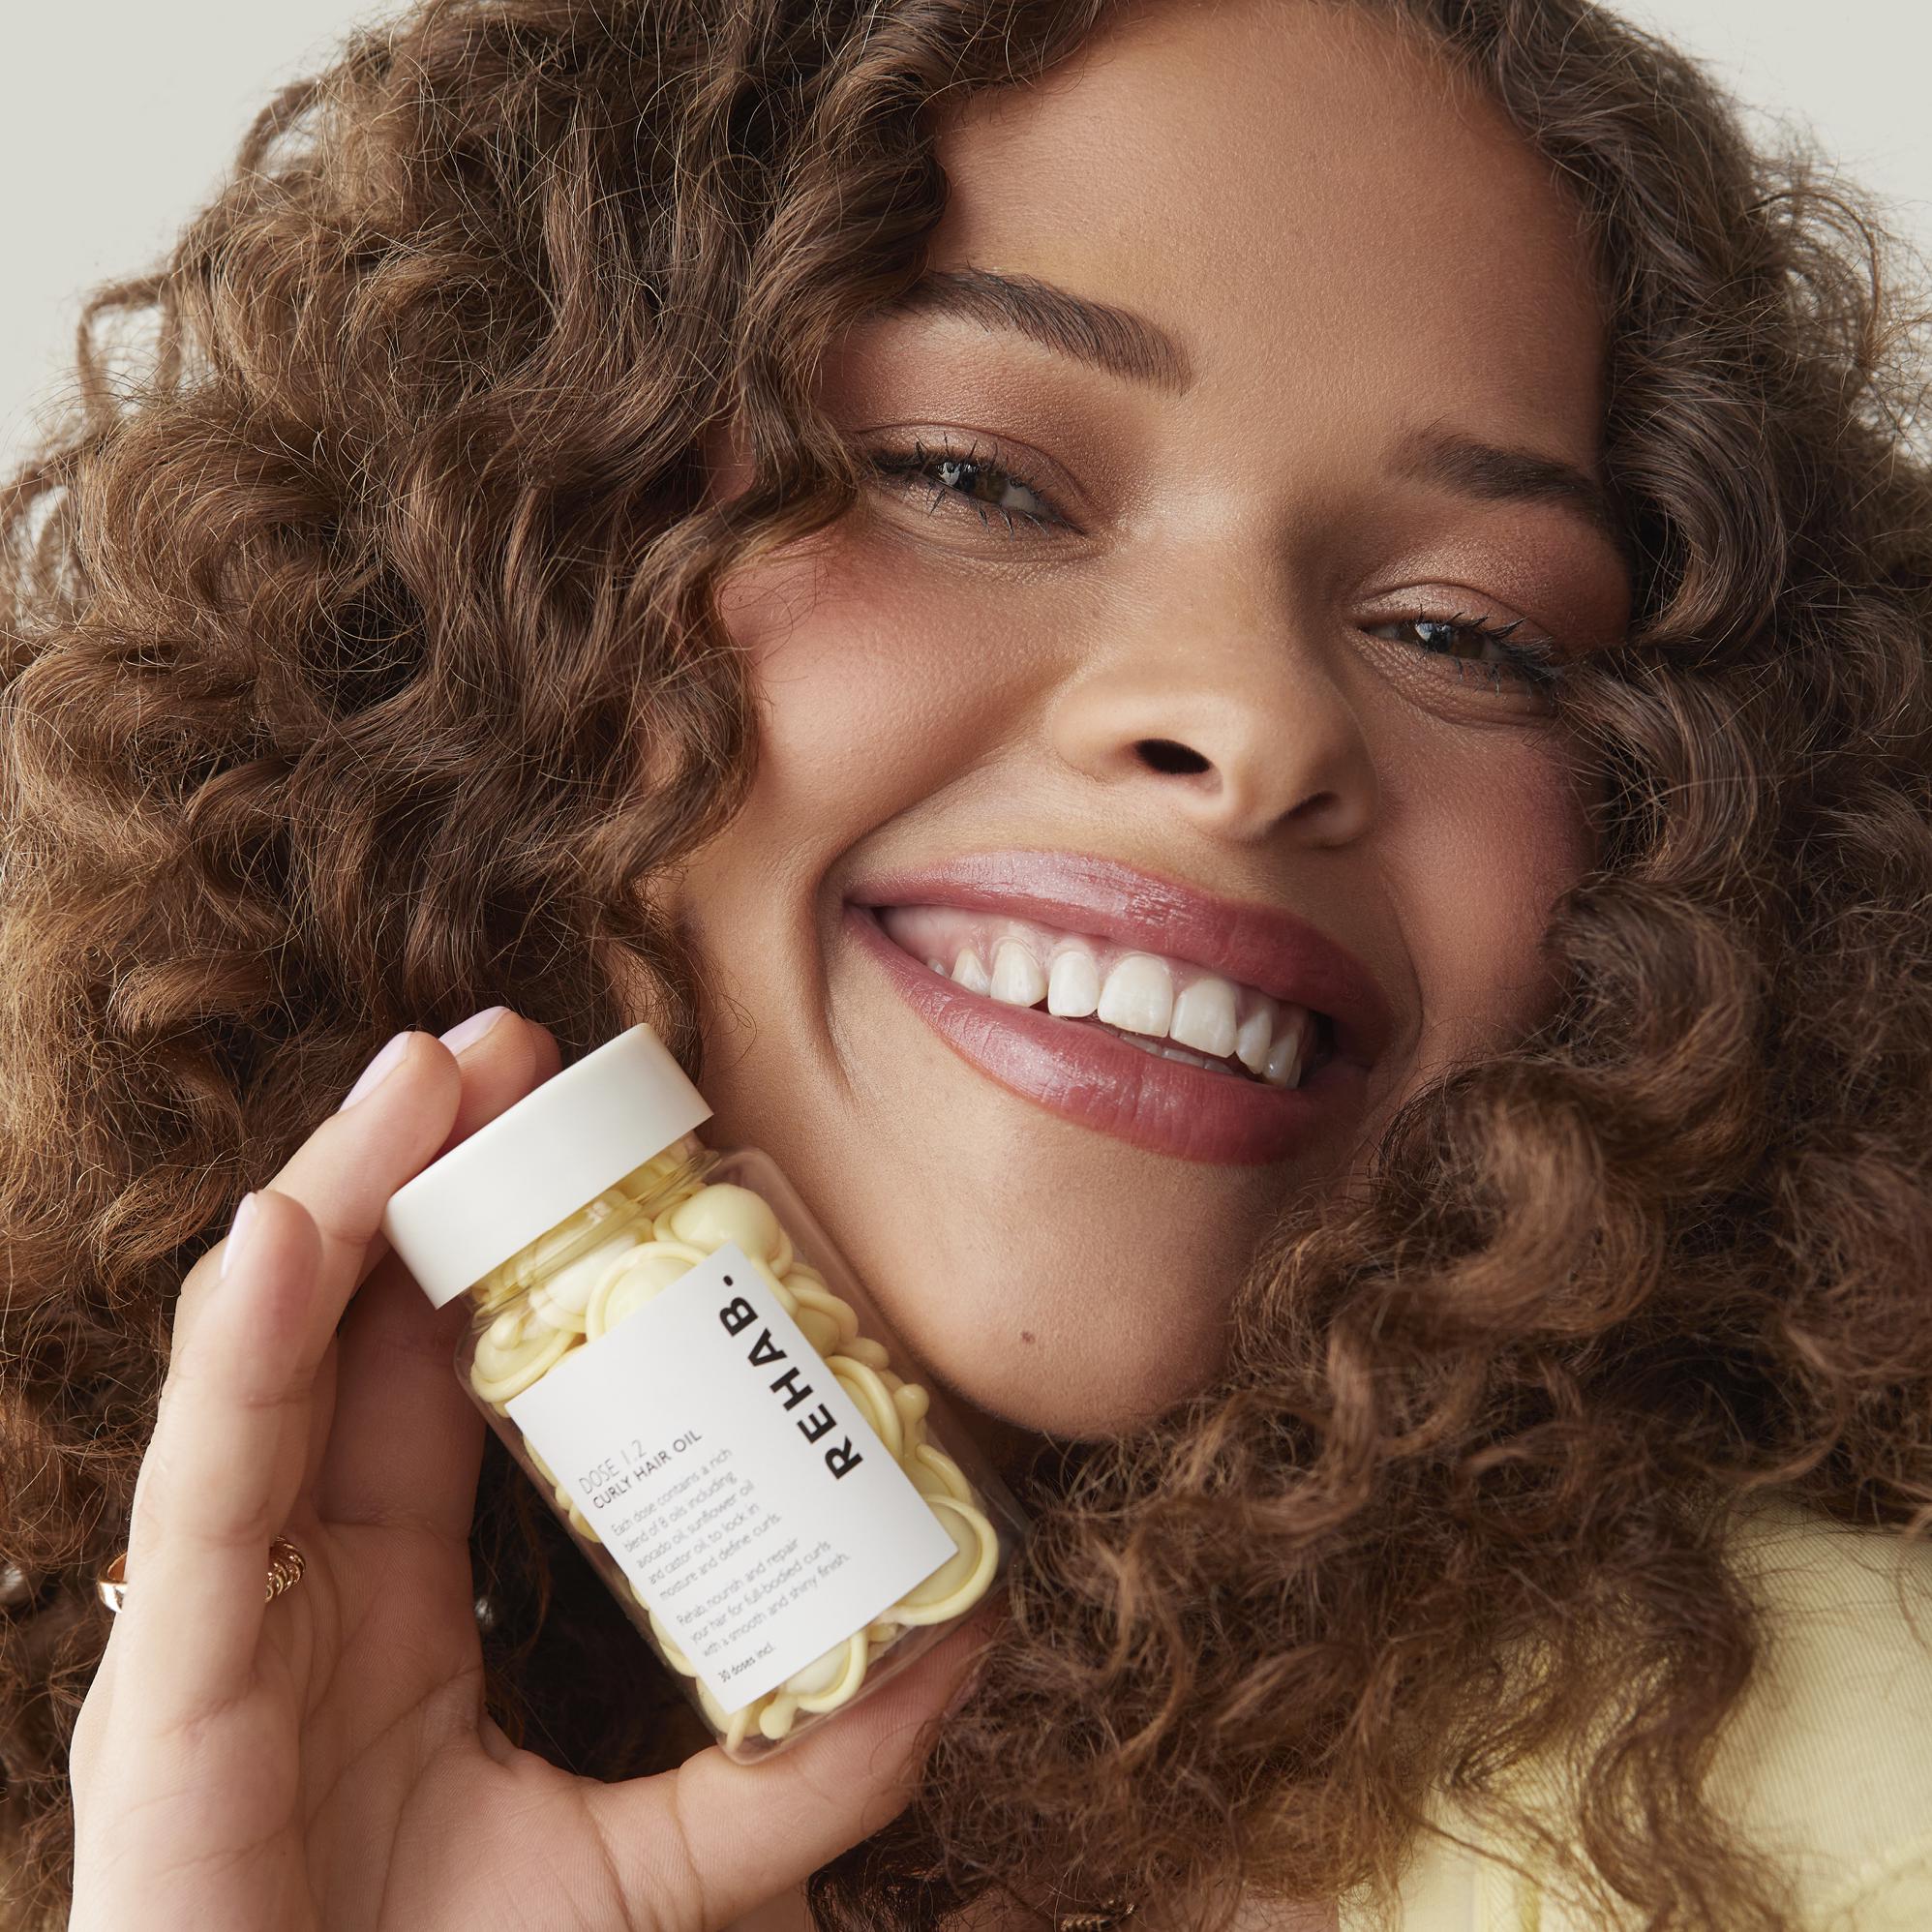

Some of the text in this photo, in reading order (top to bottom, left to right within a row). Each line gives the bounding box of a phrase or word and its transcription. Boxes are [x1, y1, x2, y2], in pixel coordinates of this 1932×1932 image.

[719, 1275, 863, 1480] REHAB.
[578, 1438, 648, 1494] DOSE 1.2
[592, 1430, 702, 1509] CURLY HAIR OIL
[610, 1448, 732, 1536] Each dose contains a rich
[621, 1470, 738, 1553] blend of 8 oils including
[635, 1540, 672, 1569] avocado
[686, 1492, 737, 1534] sunflower
[739, 1478, 755, 1496] oil
[648, 1567, 665, 1585] and
[663, 1549, 692, 1574] castor
[707, 1529, 723, 1544] to
[720, 1512, 748, 1533] lock
[744, 1502, 760, 1516] in
[689, 1540, 831, 1645] your hair for full-bodied curls
[697, 1554, 718, 1576] and
[717, 1533, 751, 1561] define
[706, 1578, 744, 1609] nourish
[743, 1560, 767, 1583] and
[766, 1537, 798, 1566] repair
[702, 1641, 721, 1657] with
[720, 1637, 730, 1646] a
[727, 1611, 767, 1642] smooth
[766, 1592, 789, 1616] and
[788, 1574, 818, 1600] shiny
[716, 1669, 731, 1683] 30
[730, 1655, 756, 1675] doses
